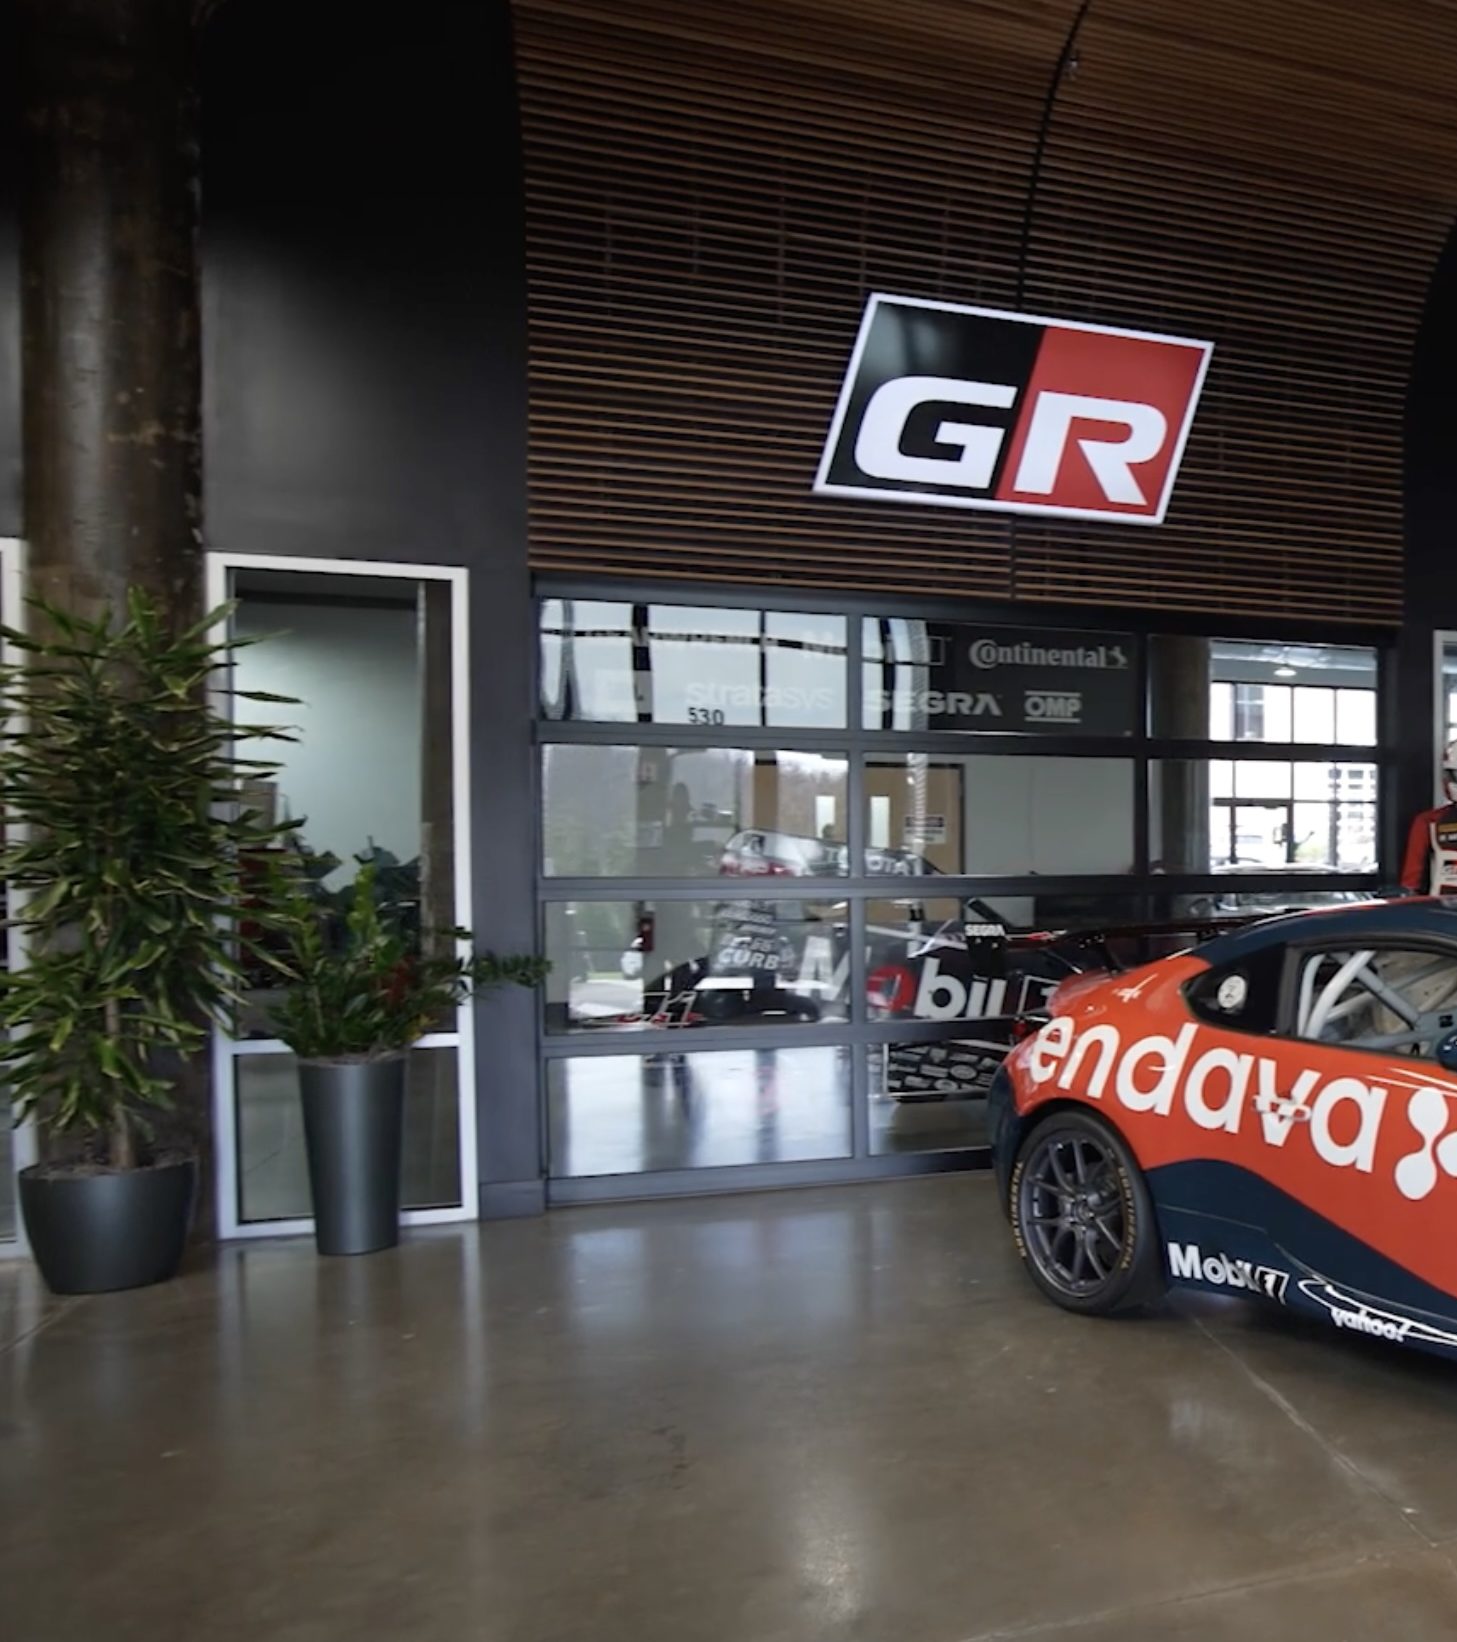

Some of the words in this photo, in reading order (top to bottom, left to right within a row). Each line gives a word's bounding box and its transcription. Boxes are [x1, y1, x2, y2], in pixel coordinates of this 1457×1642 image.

[854, 375, 1168, 506] GR
[968, 638, 1107, 669] Continental
[687, 706, 726, 726] 530
[1024, 695, 1082, 719] OMP
[1029, 1015, 1388, 1175] endava
[1167, 1242, 1262, 1293] Mobil
[1331, 1305, 1411, 1343] yahoo!
